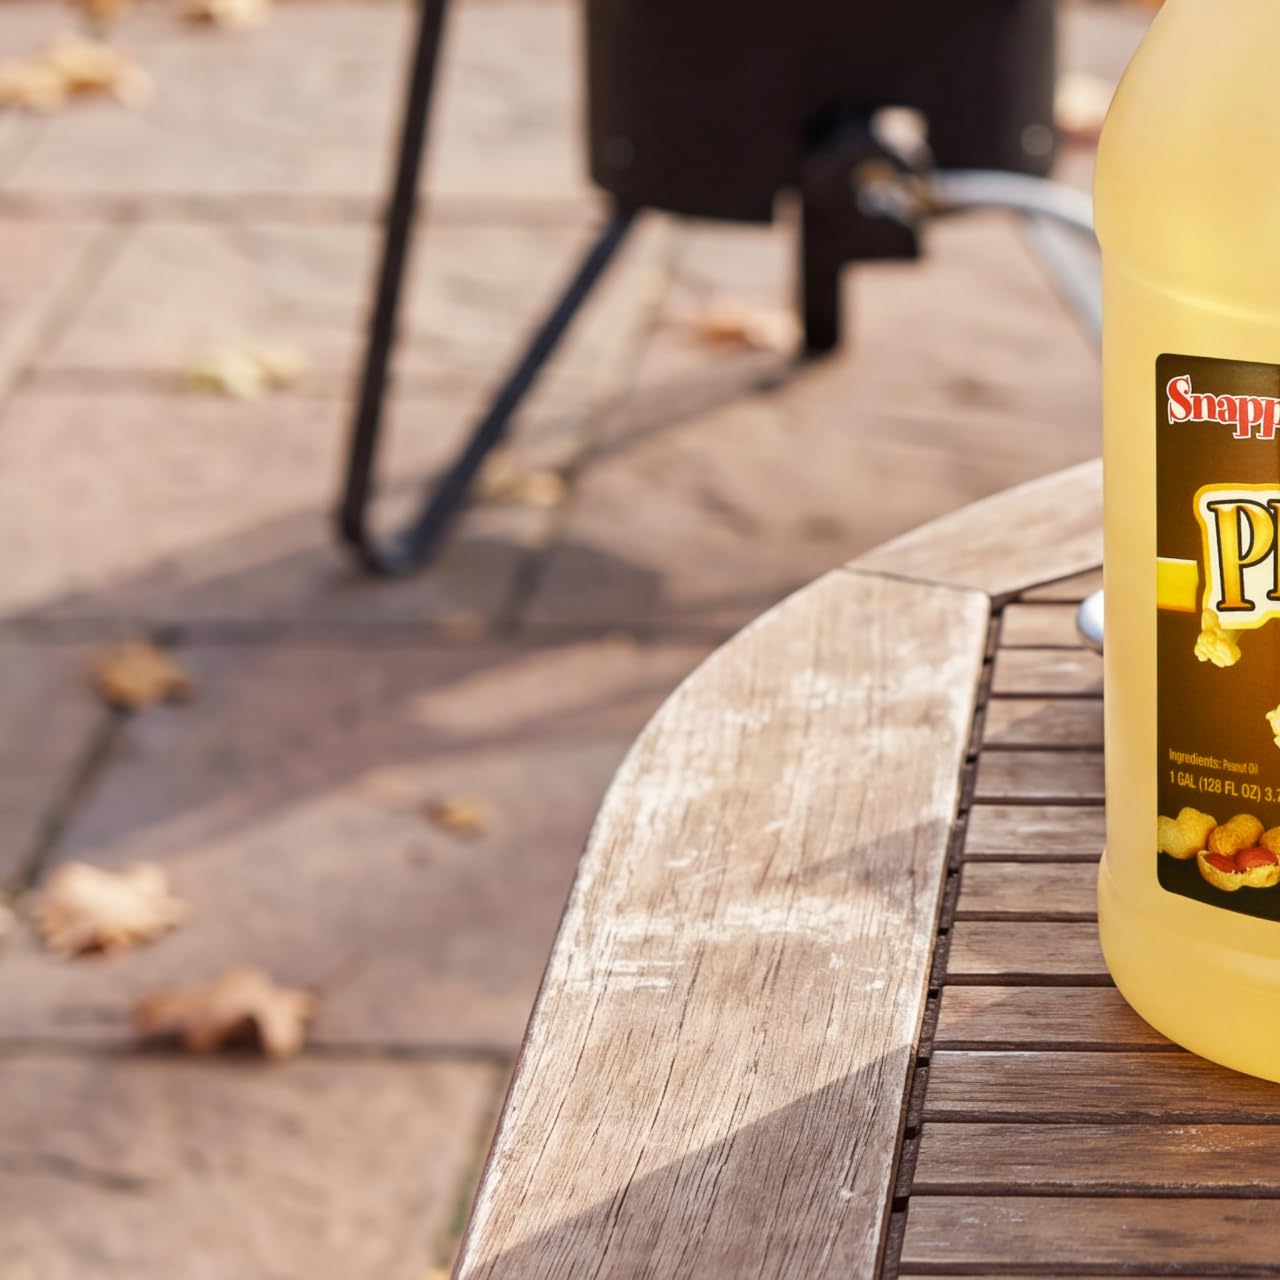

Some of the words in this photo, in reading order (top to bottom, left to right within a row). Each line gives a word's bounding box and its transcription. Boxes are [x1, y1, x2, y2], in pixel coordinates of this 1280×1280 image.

[1169, 748, 1221, 769] Ingredients:
[1223, 759, 1247, 774] Peanut
[1170, 772, 1174, 784] 1
[1177, 772, 1196, 788] GAL
[1199, 777, 1222, 794] (128
[1225, 782, 1238, 797] FL
[1241, 784, 1261, 802] OZ)
